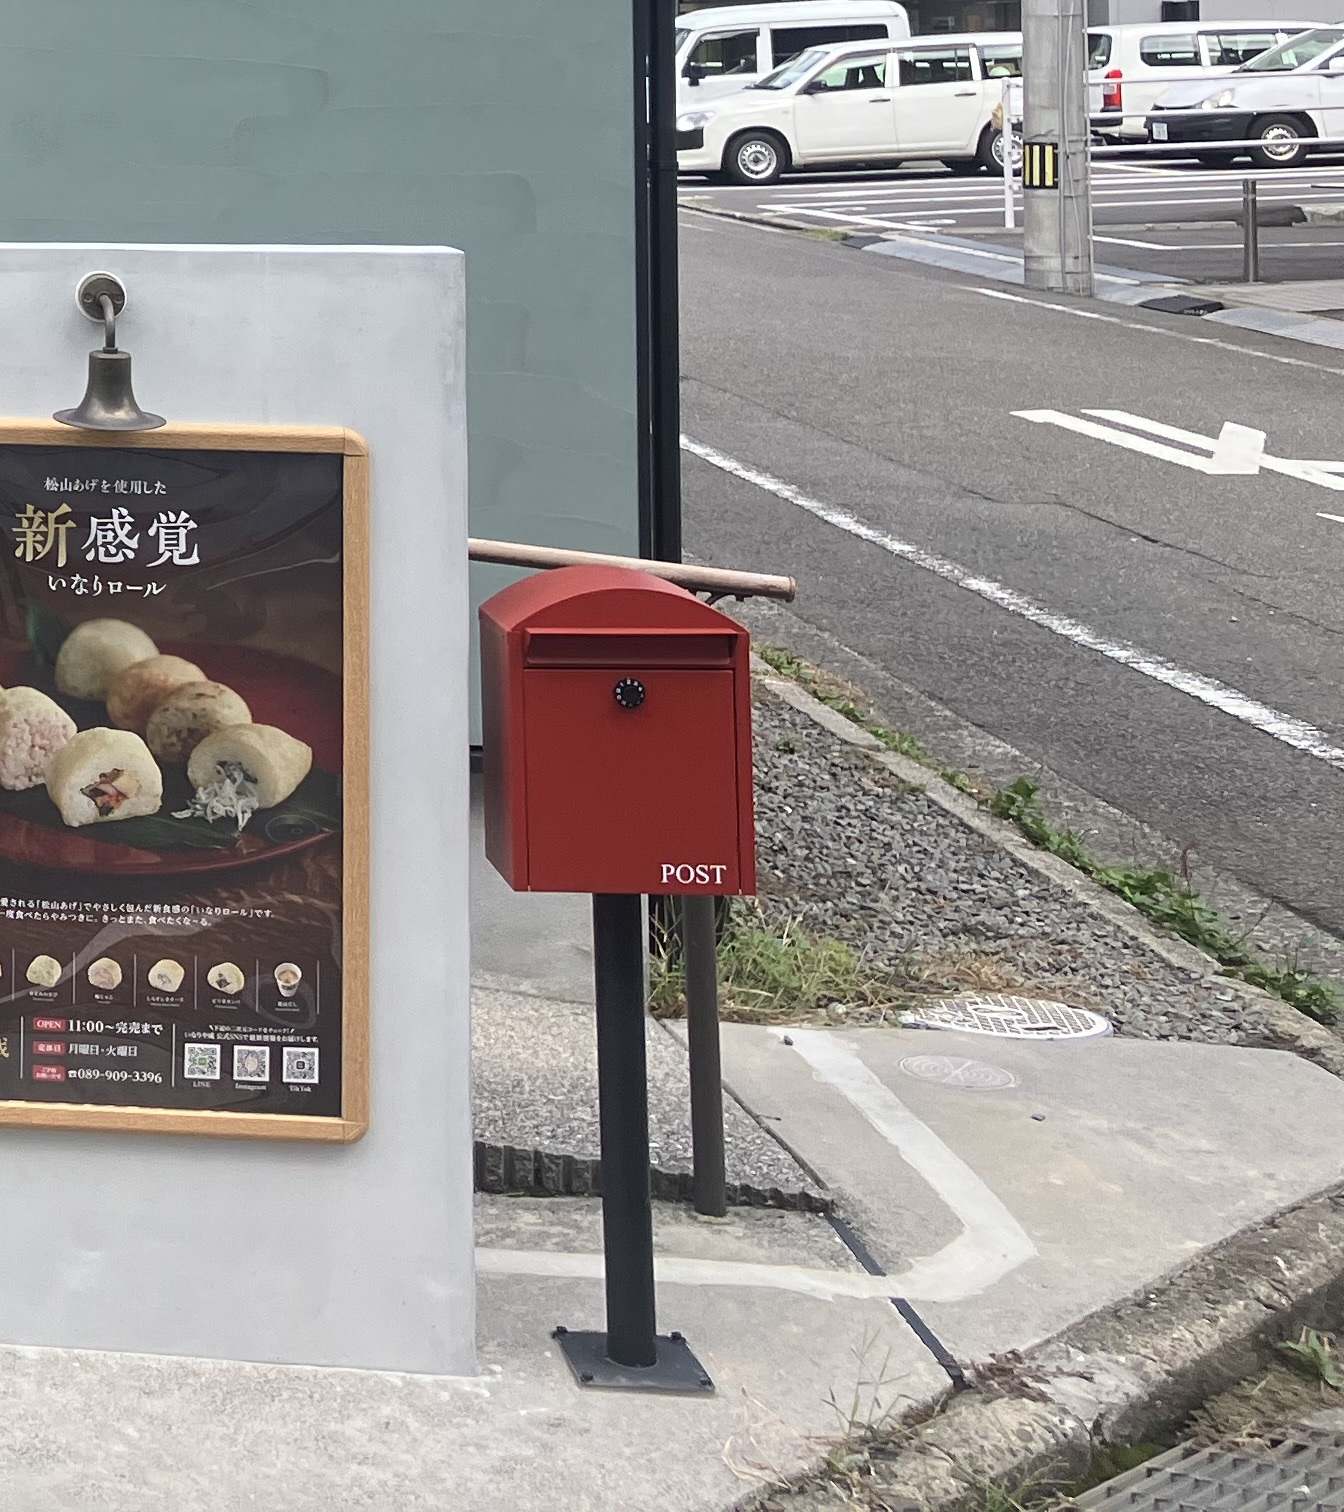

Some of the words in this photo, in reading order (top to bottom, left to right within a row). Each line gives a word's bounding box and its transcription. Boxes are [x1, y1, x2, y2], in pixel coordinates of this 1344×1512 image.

[12, 502, 201, 568] 新感覚
[48, 573, 167, 598] いなりロール
[660, 863, 727, 885] POST
[36, 1019, 62, 1029] OPEN
[78, 1068, 163, 1084] 089-909-3396
[192, 1080, 212, 1088] LINE
